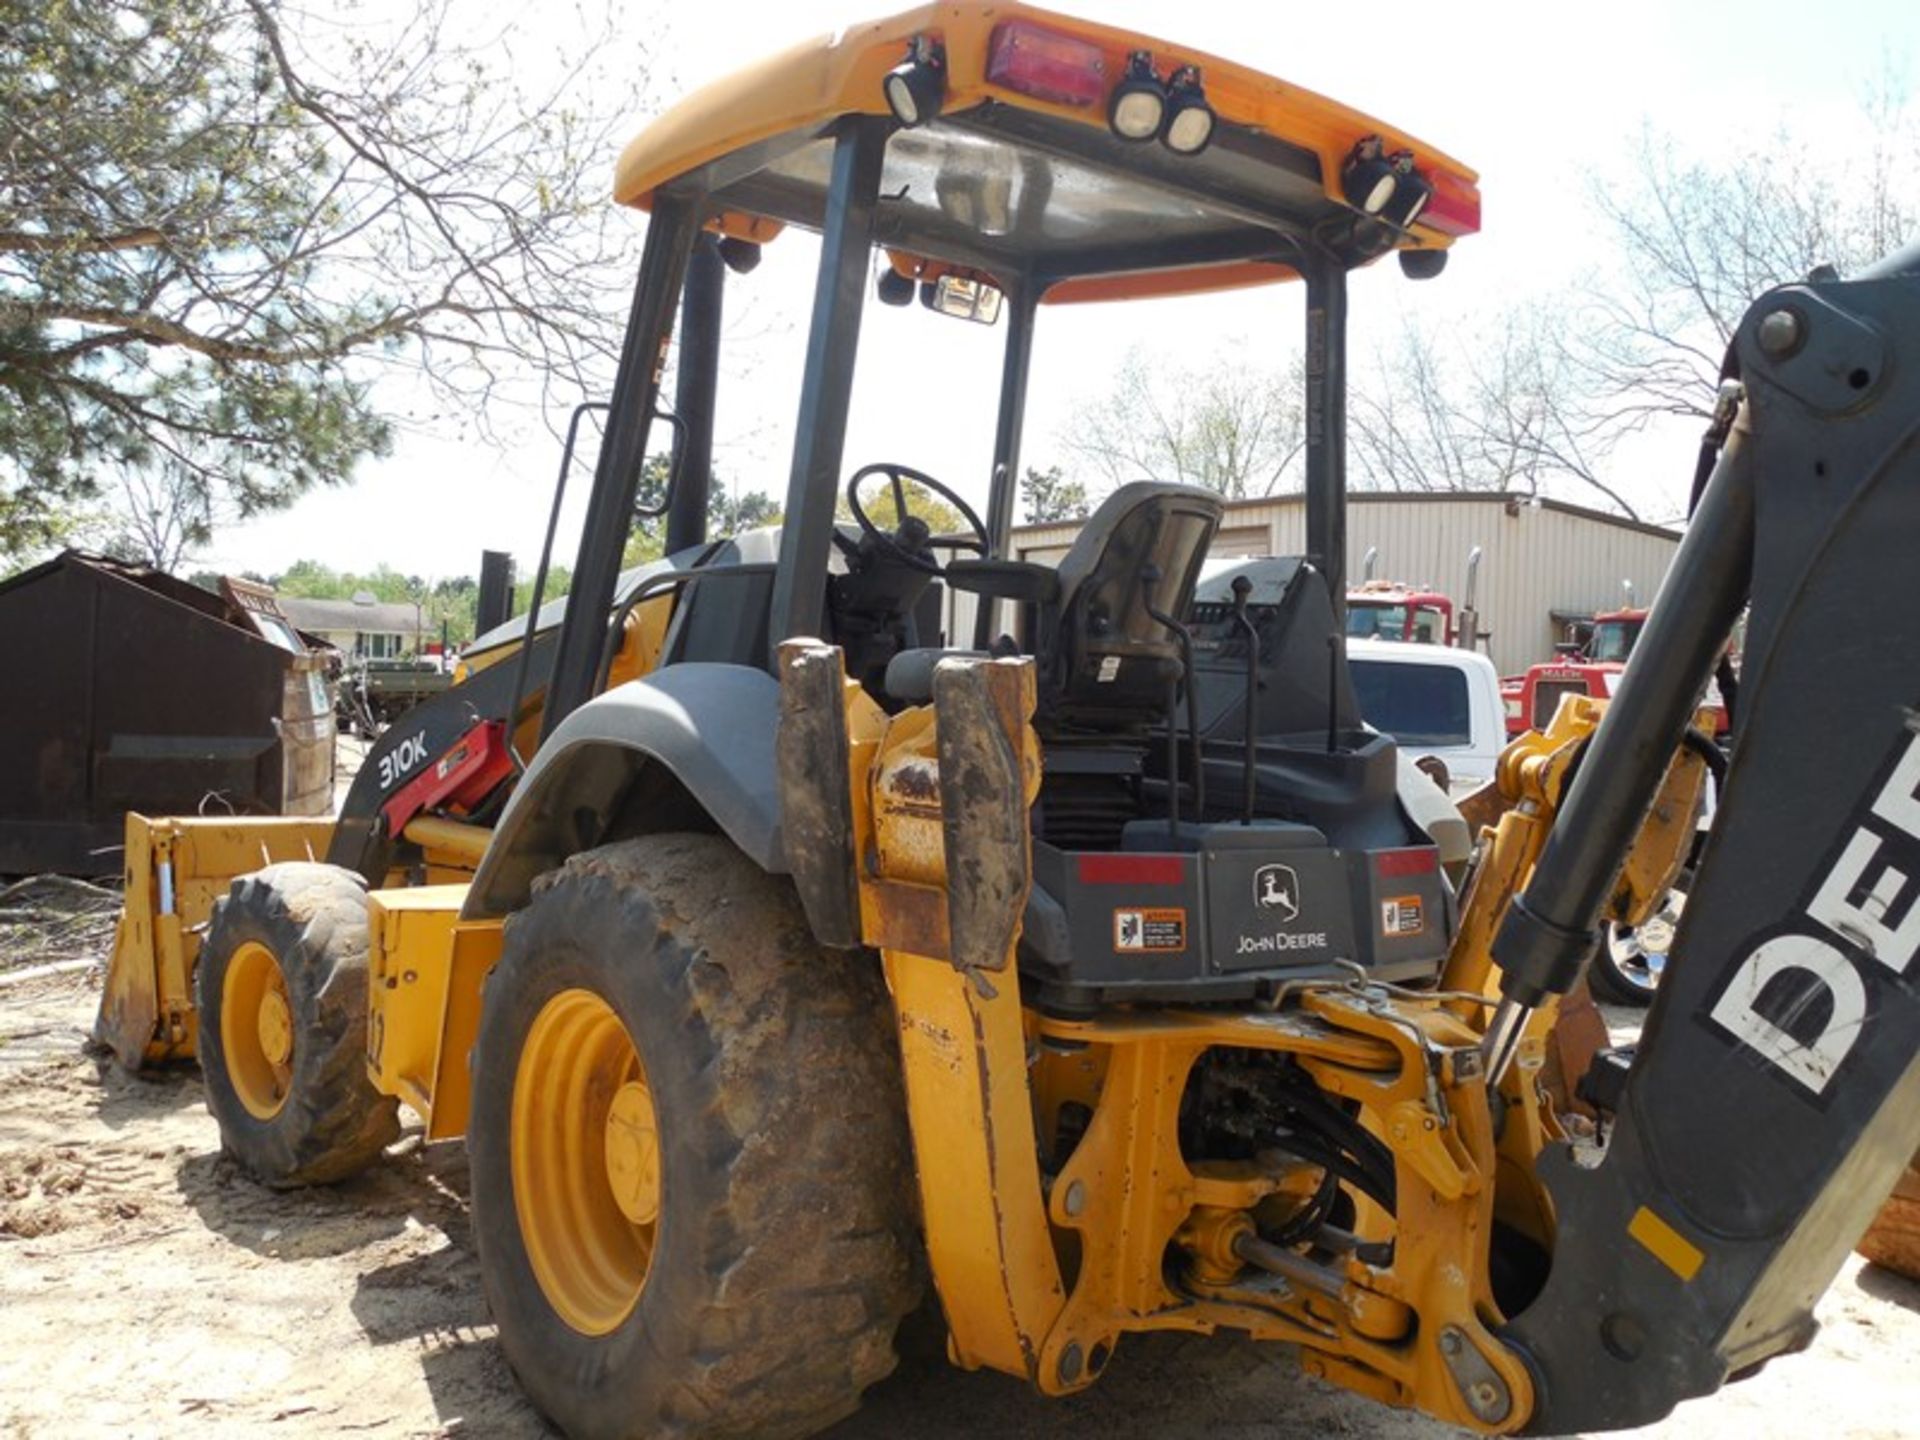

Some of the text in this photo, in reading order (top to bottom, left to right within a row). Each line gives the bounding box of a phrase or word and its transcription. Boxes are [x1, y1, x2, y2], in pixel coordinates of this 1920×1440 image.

[379, 730, 428, 789] 310K
[1236, 932, 1327, 953] JOHN DEERE
